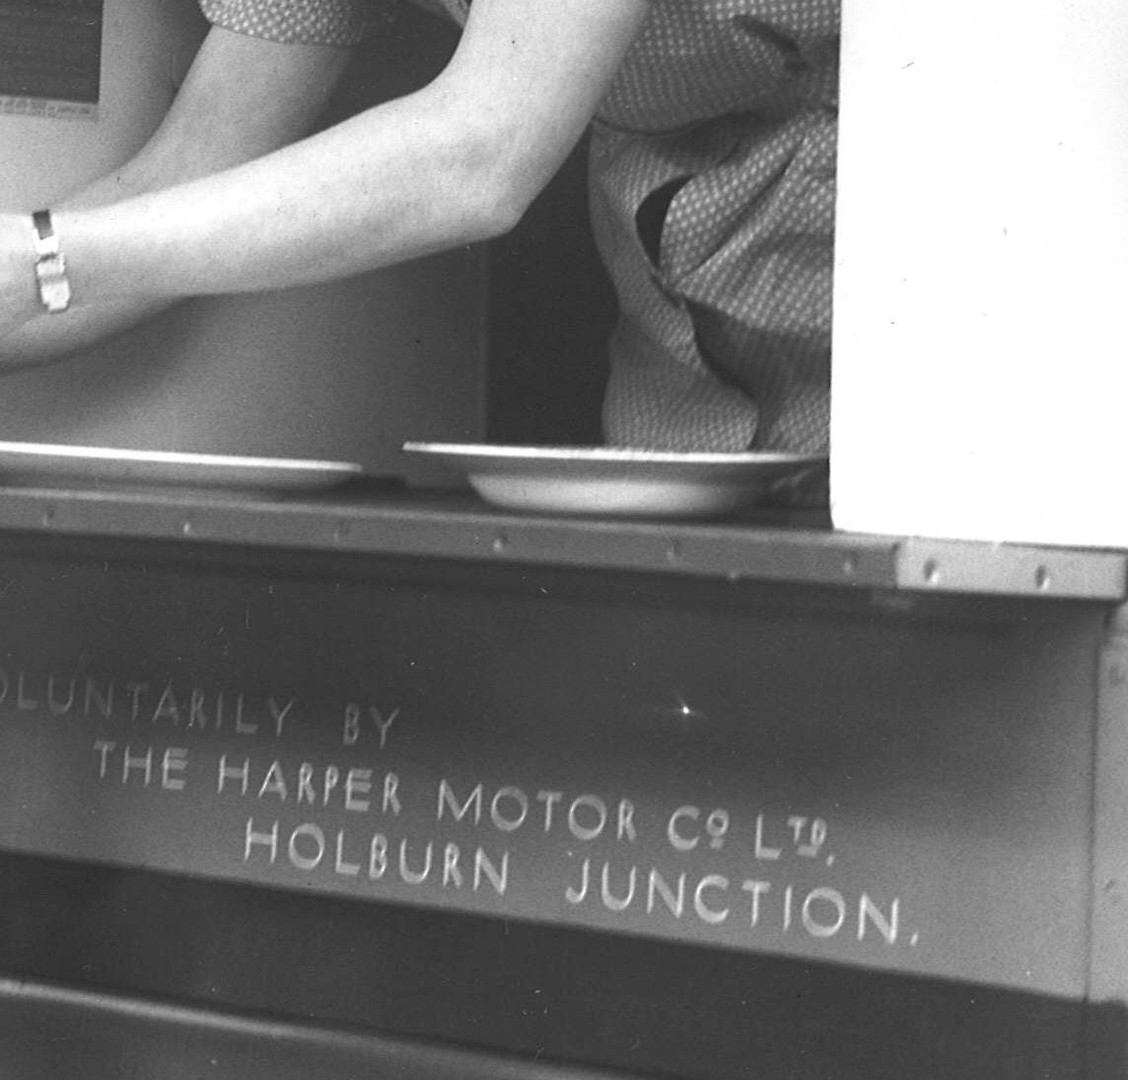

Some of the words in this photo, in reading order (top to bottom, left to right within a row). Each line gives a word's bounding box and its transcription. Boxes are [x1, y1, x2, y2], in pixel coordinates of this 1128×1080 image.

[343, 702, 400, 748] BY
[93, 740, 189, 791] THE
[217, 754, 402, 815] HARPER
[437, 778, 637, 842] MOTOR
[245, 816, 509, 896] HOLBURN
